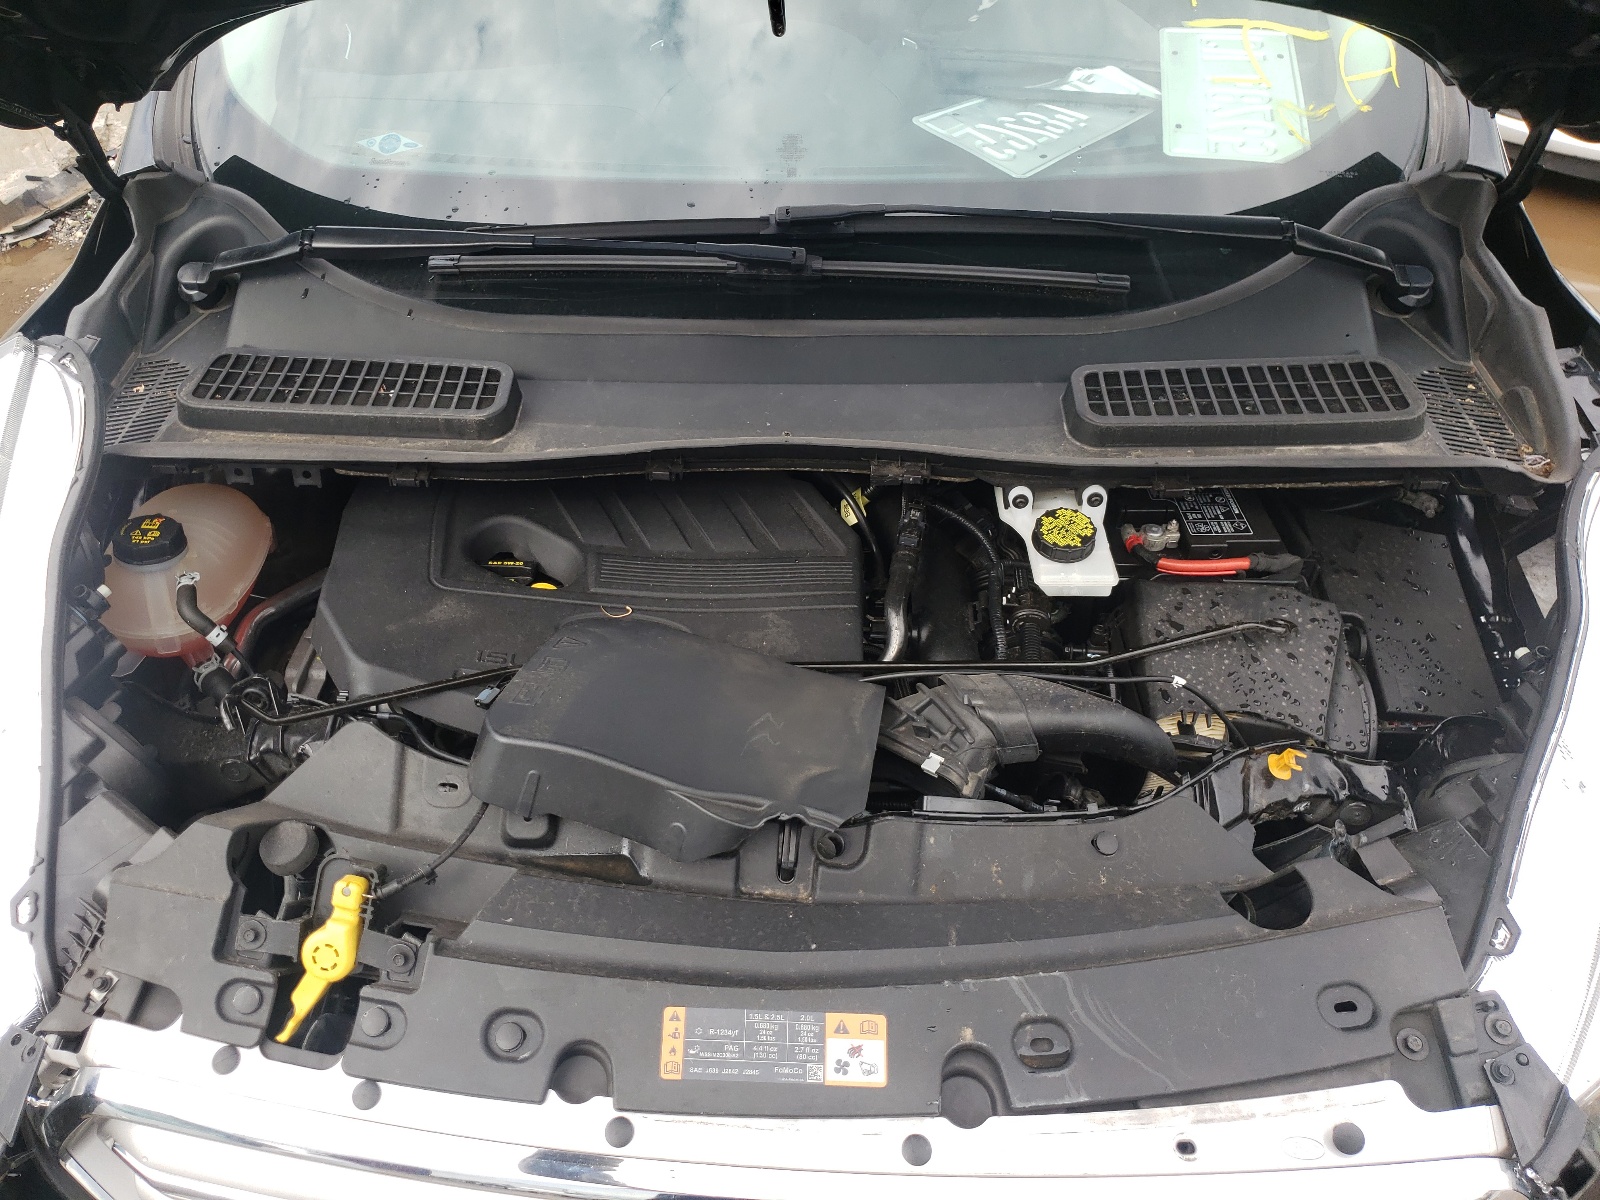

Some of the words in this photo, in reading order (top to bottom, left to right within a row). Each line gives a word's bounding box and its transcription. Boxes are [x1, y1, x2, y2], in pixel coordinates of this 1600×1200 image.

[811, 1024, 820, 1032] kg
[709, 1029, 739, 1037] R-1234yf
[724, 1044, 739, 1052] PAG
[774, 1066, 803, 1074] FoMoCo
